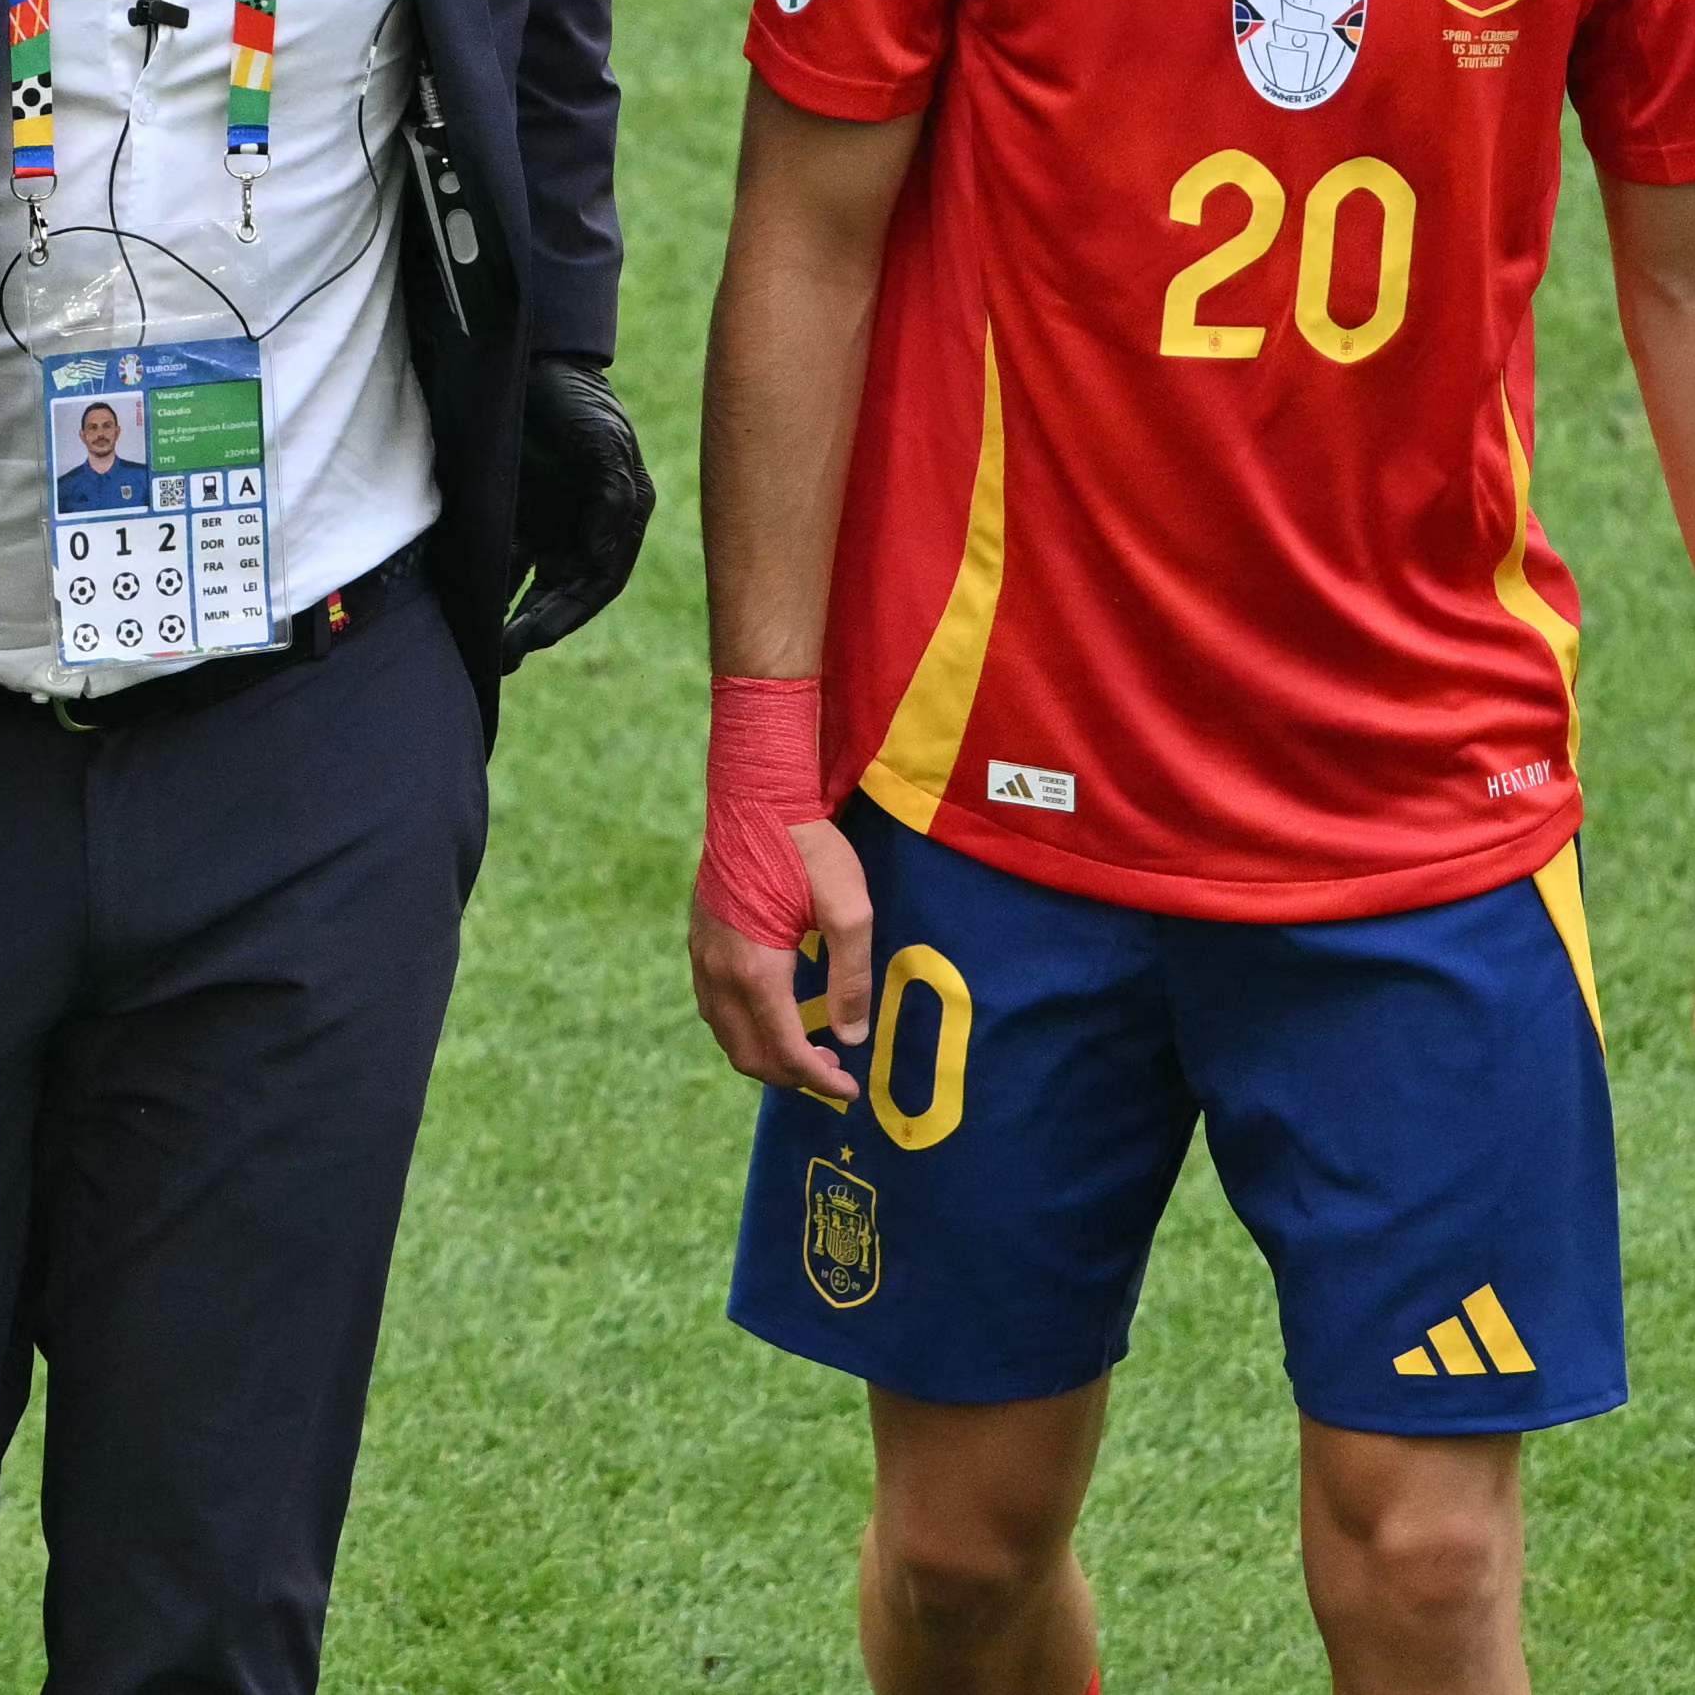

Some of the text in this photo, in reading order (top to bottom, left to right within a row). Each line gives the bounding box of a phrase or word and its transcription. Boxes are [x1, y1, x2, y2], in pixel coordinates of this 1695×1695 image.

[1442, 29, 1472, 43] SPAIN
[1468, 43, 1486, 55] JULY
[1487, 43, 1511, 55] 2024
[1457, 57, 1505, 69] STUTTGART
[1261, 82, 1328, 103] WINNER 2023
[1159, 148, 1417, 365] 20
[239, 476, 256, 498] A
[201, 517, 222, 528] BER
[238, 514, 259, 524] COL
[69, 522, 177, 561] 0 1 2
[201, 538, 225, 550] DOR
[238, 535, 260, 547] DUS
[203, 561, 224, 572] FRA
[240, 558, 260, 569] GEL
[203, 585, 228, 596] HAM
[243, 582, 258, 593] LEI
[204, 610, 230, 621] MUN
[242, 607, 263, 618] STU
